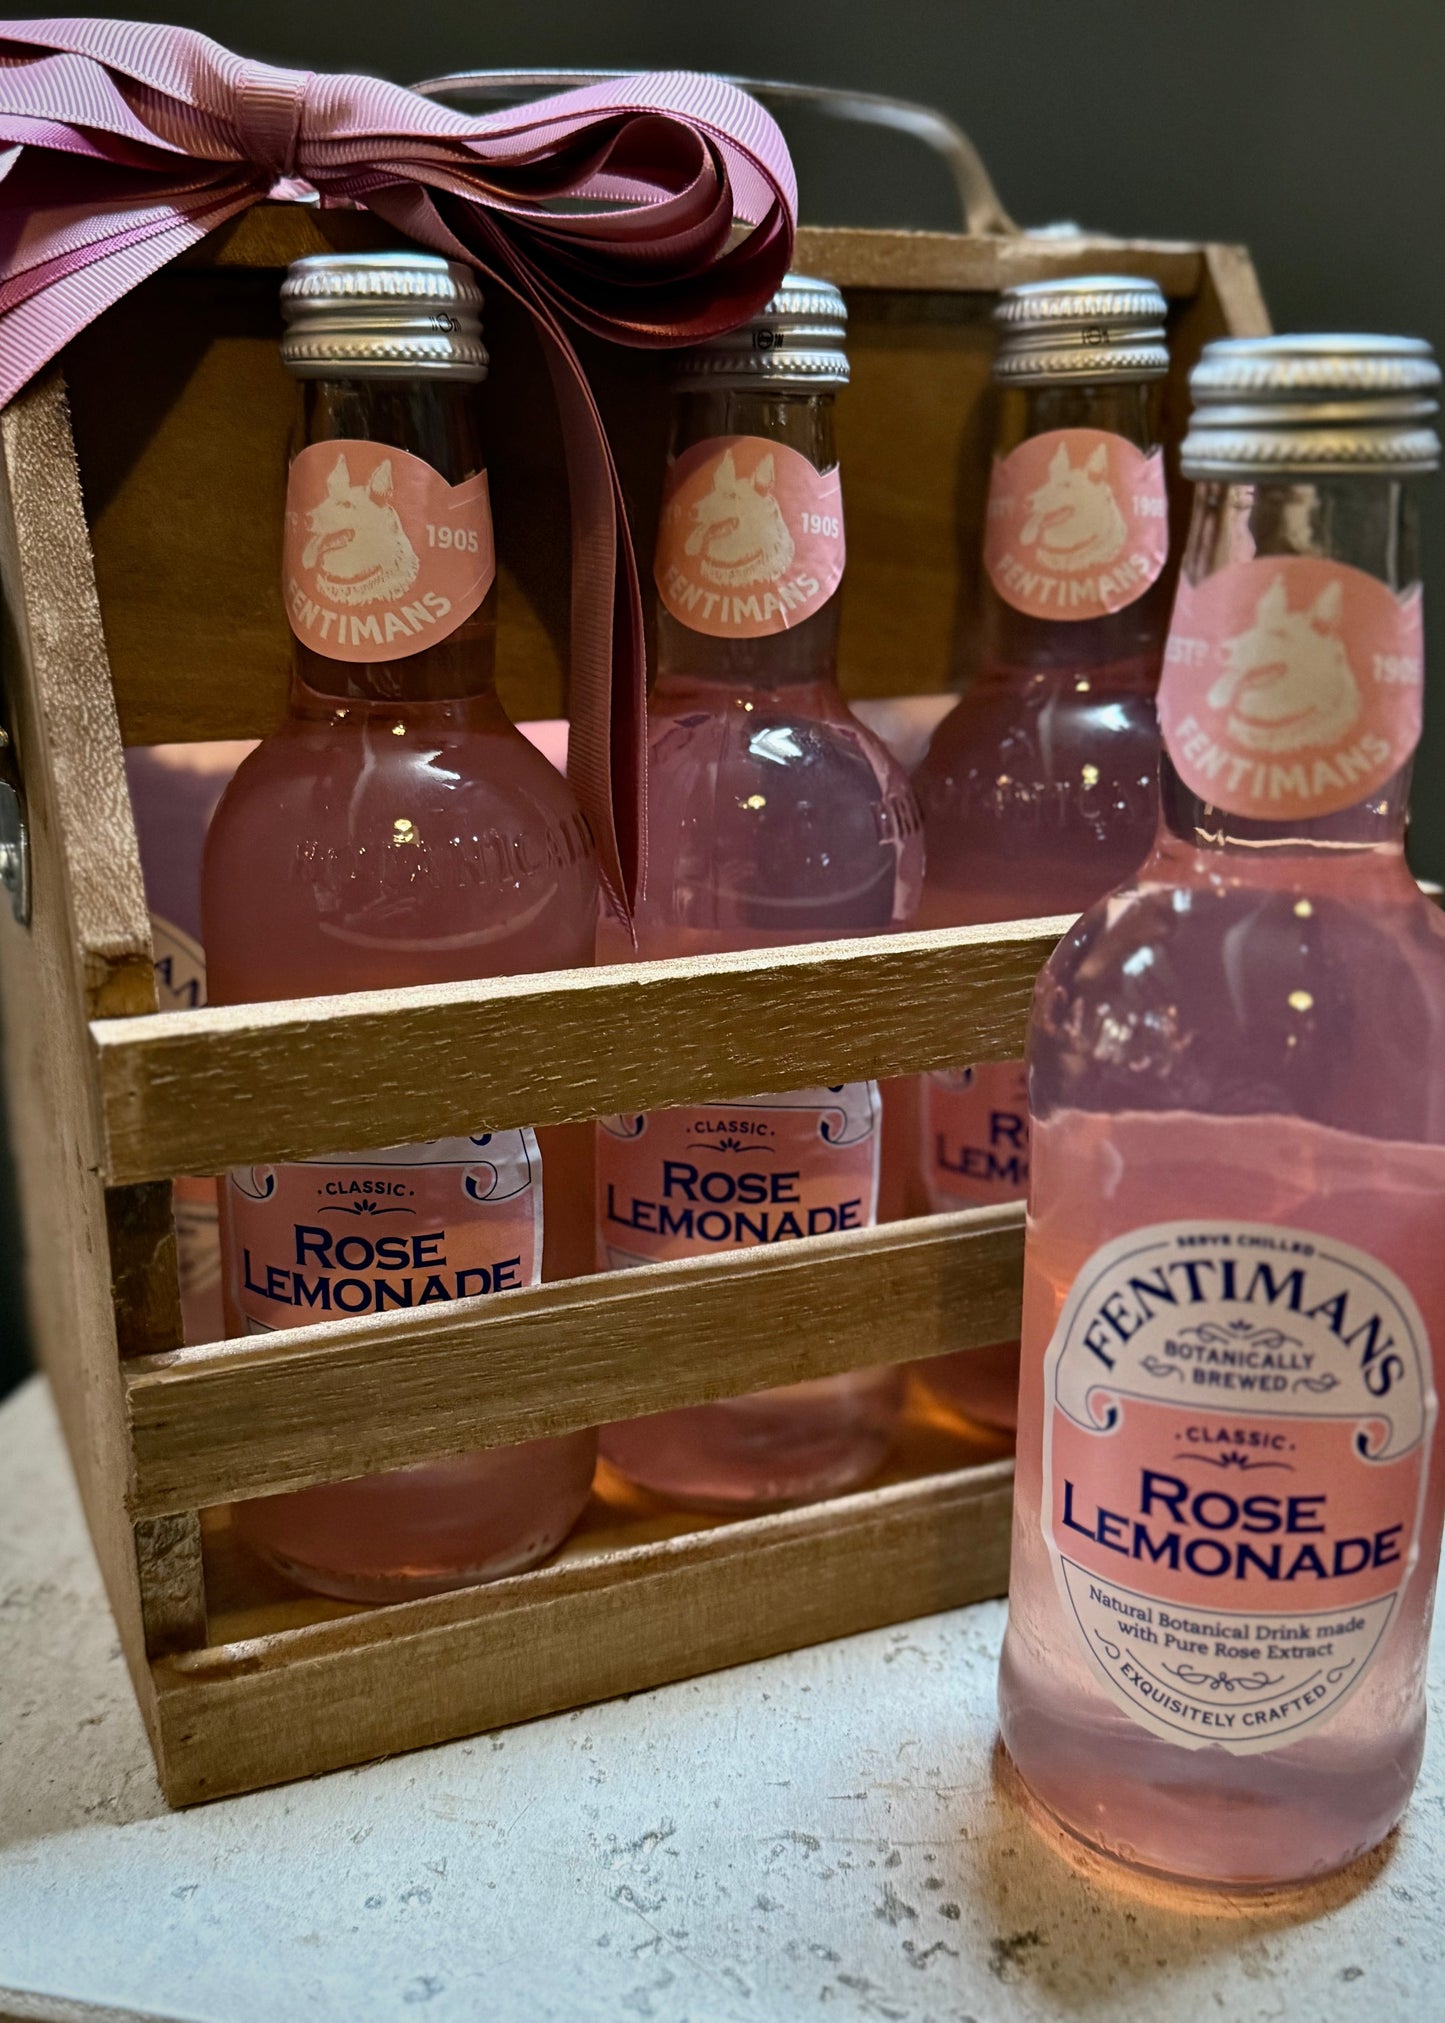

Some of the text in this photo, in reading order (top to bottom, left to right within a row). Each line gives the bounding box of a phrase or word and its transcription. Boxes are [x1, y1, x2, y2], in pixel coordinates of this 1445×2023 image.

[425, 524, 479, 553] 1905
[799, 511, 839, 538] 1905
[997, 553, 1151, 608] FENTIMANS
[1175, 713, 1391, 801] FENTIMANS
[694, 1120, 768, 1137] CLASSIC
[325, 1180, 407, 1197] CLASSIC
[662, 1160, 800, 1203] ROSE
[607, 1183, 862, 1243] LEMONADE
[293, 1223, 448, 1272] ROSE
[1236, 1234, 1316, 1257] CHILLED
[243, 1247, 523, 1313] LEMONADE
[1082, 1258, 1405, 1398] FENTIMANS
[1164, 1340, 1316, 1372] BOTANICALLY
[1192, 1369, 1289, 1393] BREWED
[1186, 1426, 1288, 1451] CLASSIC
[1139, 1467, 1328, 1534] ROSE
[1061, 1478, 1404, 1580] LEMONADE
[1089, 1583, 1367, 1643] Natural Botanical Drink made
[1117, 1620, 1335, 1661] with Pure Rose Extract
[1119, 1660, 1329, 1729] EXQUISITELY CRAFTED
